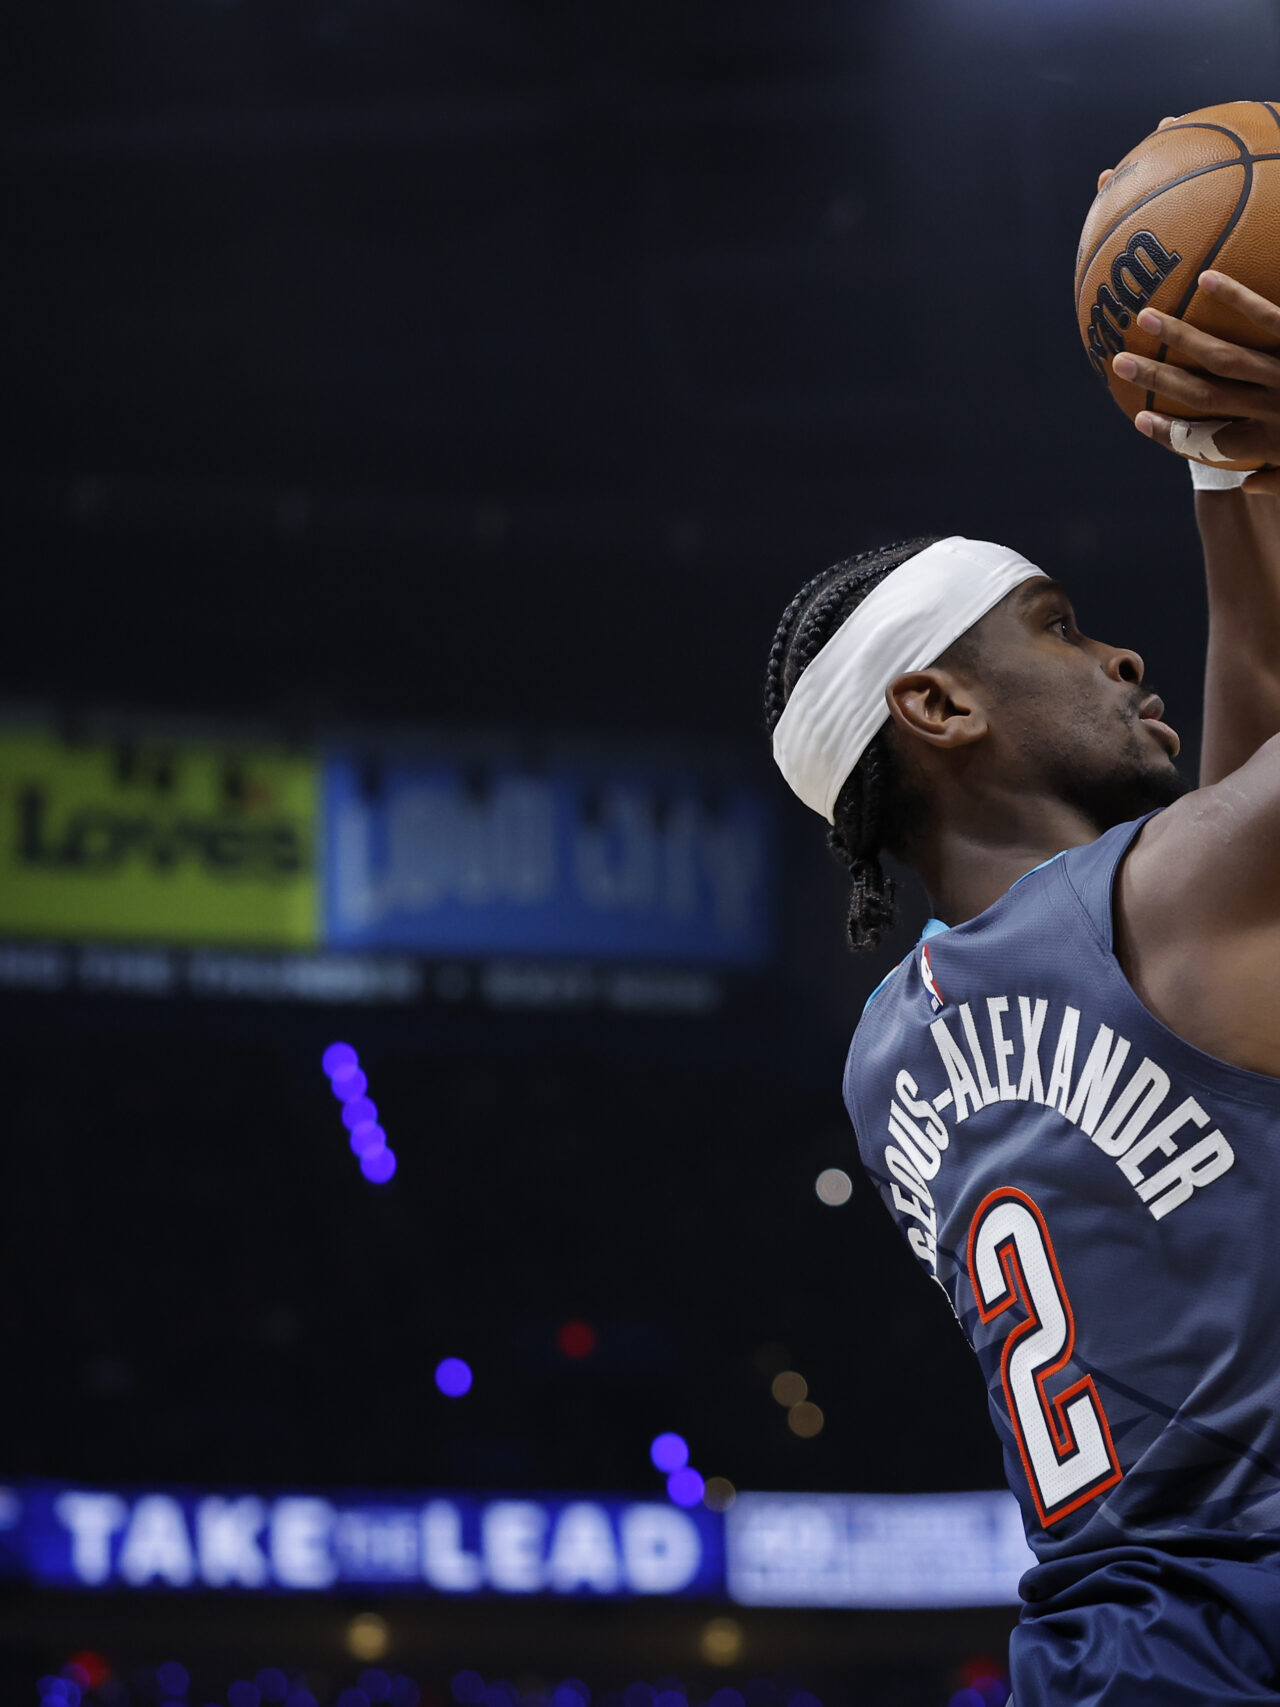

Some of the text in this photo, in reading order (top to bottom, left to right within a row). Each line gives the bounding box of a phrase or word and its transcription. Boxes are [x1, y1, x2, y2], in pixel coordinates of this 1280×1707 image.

[885, 996, 1236, 1318] GEOUS-ALEXANDER
[966, 1186, 1123, 1528] 2
[58, 1494, 338, 1590] TAKE
[421, 1502, 703, 1594] LEAD
